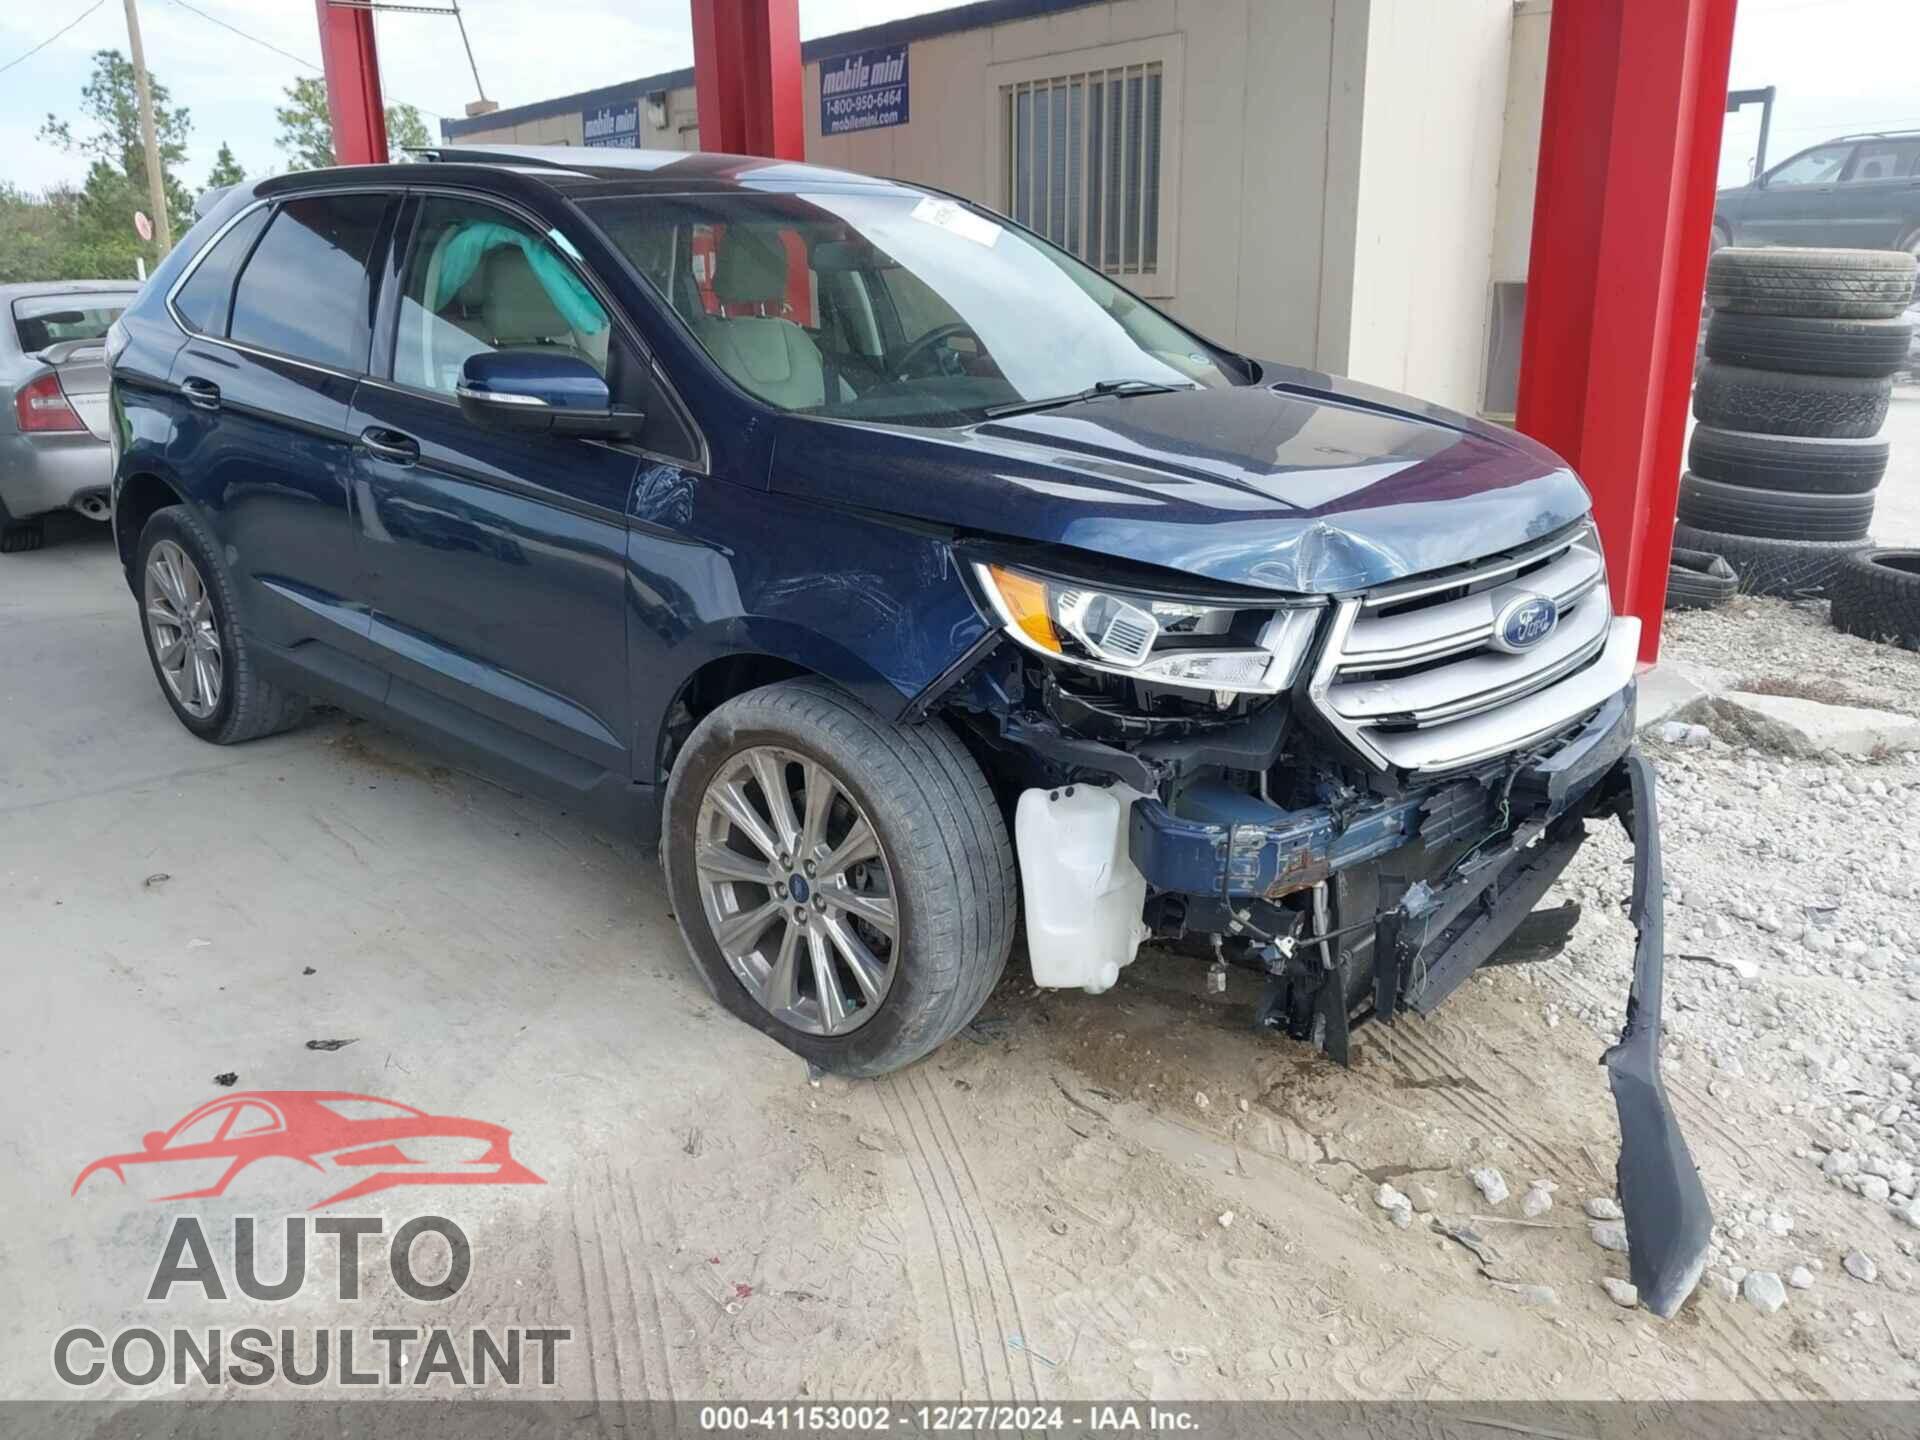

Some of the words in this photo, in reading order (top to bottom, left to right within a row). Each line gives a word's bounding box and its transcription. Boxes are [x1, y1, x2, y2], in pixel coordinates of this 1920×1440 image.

[823, 56, 869, 96] mobile
[871, 52, 905, 86] mini
[826, 89, 902, 115] 1-800-950-6464
[832, 111, 899, 131] mobilemini.com
[1518, 606, 1552, 641] Ford
